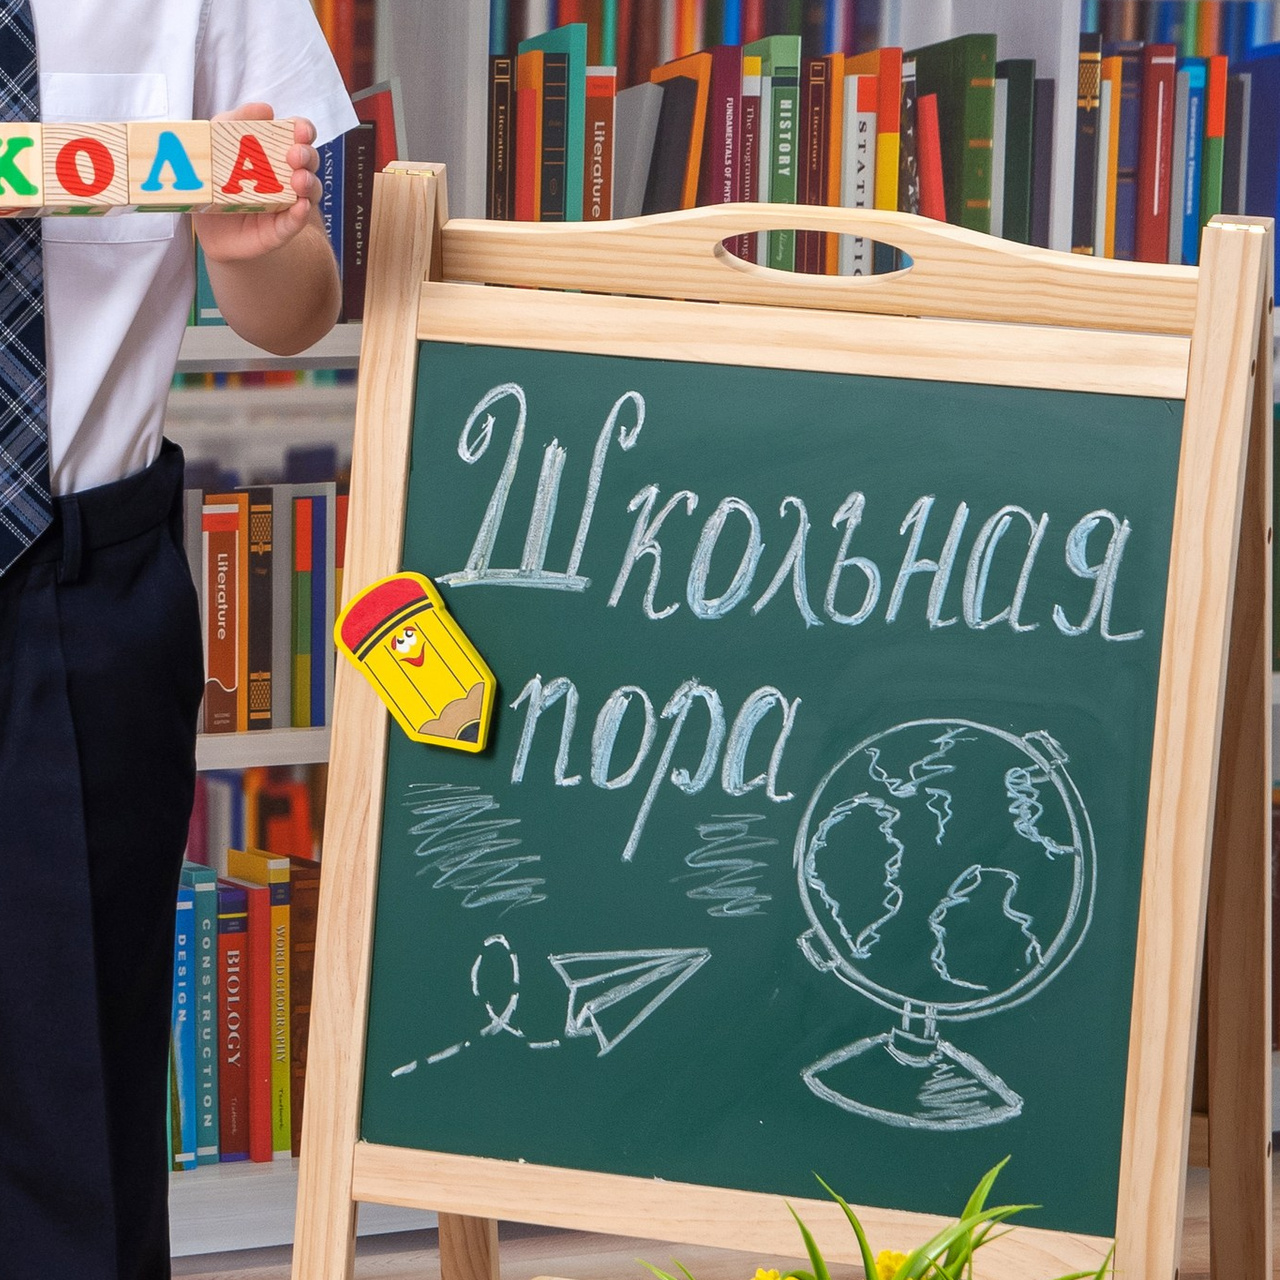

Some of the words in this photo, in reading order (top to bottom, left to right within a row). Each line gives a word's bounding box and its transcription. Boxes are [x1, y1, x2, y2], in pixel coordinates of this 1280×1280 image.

[496, 104, 506, 173] Literature
[724, 97, 734, 166] FUNDAMENTALS
[746, 105, 755, 130] The
[778, 99, 793, 176] HISTORY
[811, 106, 820, 170] Literature
[906, 98, 916, 196] ATLA
[323, 141, 334, 211] LASSICAL
[357, 145, 366, 198] Linear
[591, 120, 606, 219] Literature
[723, 180, 732, 203] PHYS
[724, 167, 732, 179] OF
[742, 133, 754, 202] Programm
[354, 205, 365, 266] Algebra
[435, 382, 1147, 642] Школьная
[216, 552, 228, 641] Literature
[509, 674, 803, 862] пора
[177, 933, 187, 1023] DESIGN
[275, 924, 287, 977] WORLD
[201, 917, 213, 1128] CONSTRUCTION
[225, 949, 241, 1067] BIOLOGY
[274, 978, 286, 1064] GEOGRAPHY
